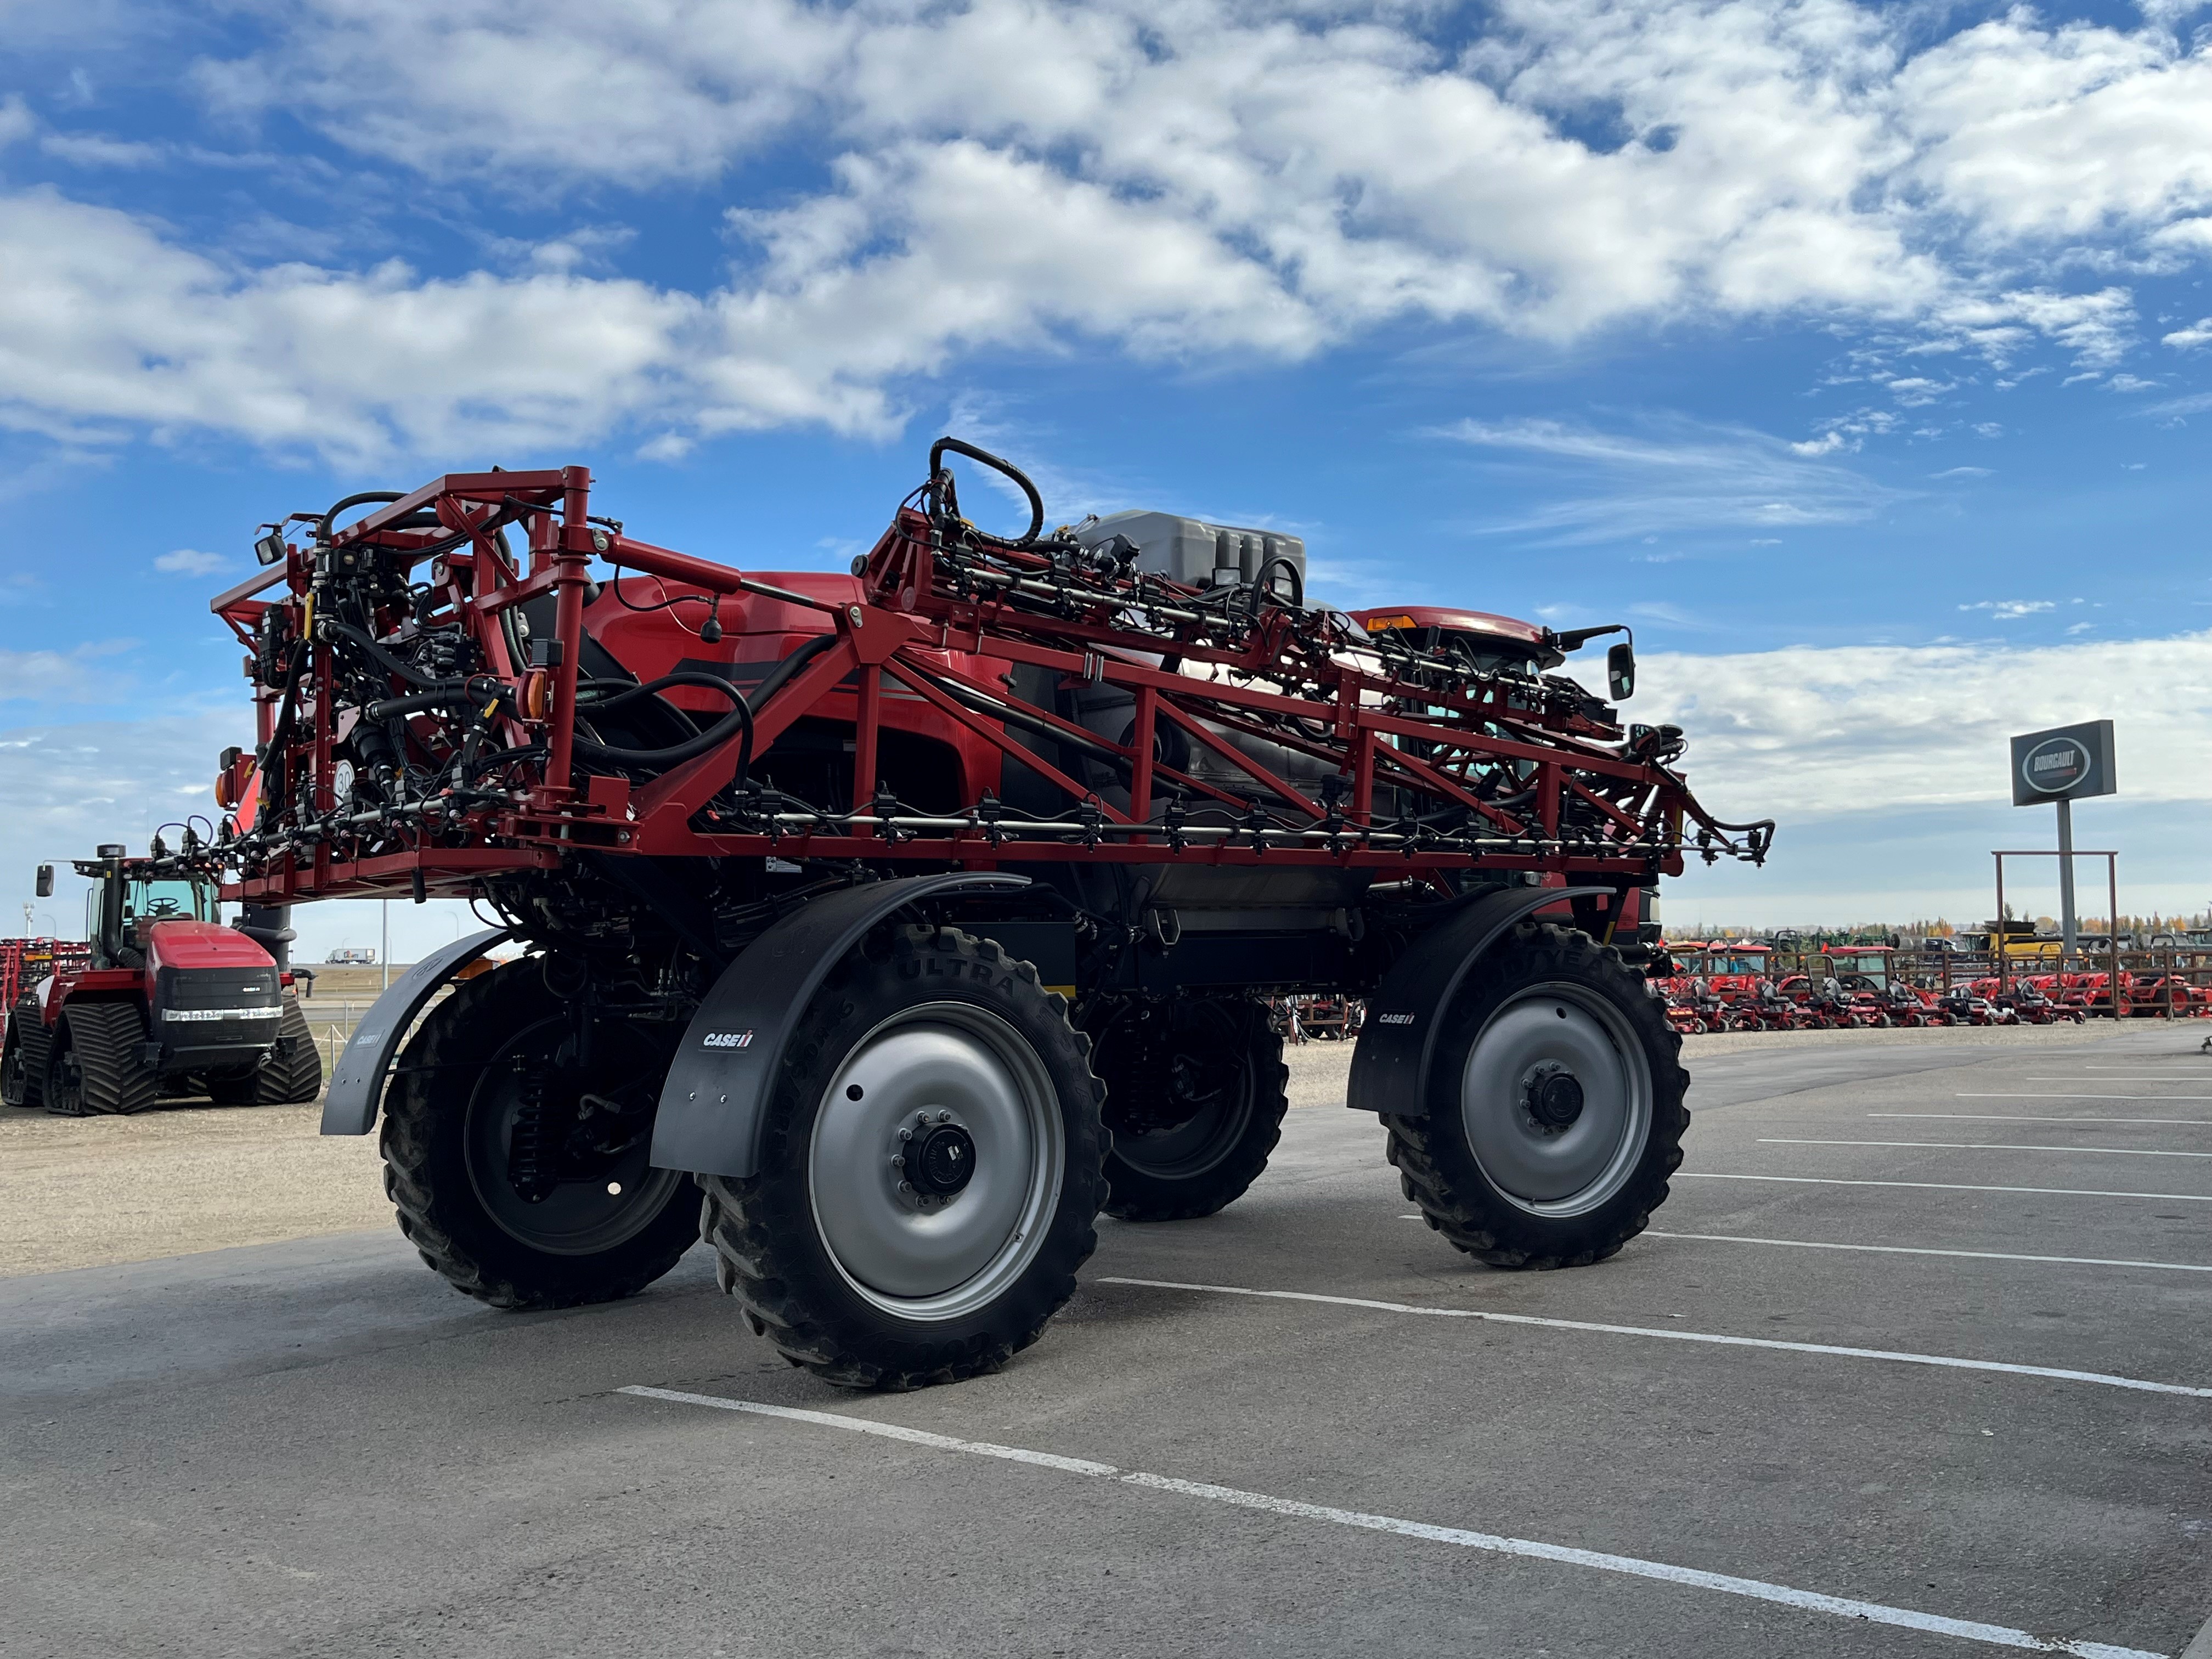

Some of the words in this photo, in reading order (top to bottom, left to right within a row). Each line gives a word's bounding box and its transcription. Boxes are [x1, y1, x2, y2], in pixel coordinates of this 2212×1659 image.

[2034, 749, 2075, 772] BOURGAULT
[338, 771, 351, 793] 30
[898, 958, 1014, 997] ULTRA
